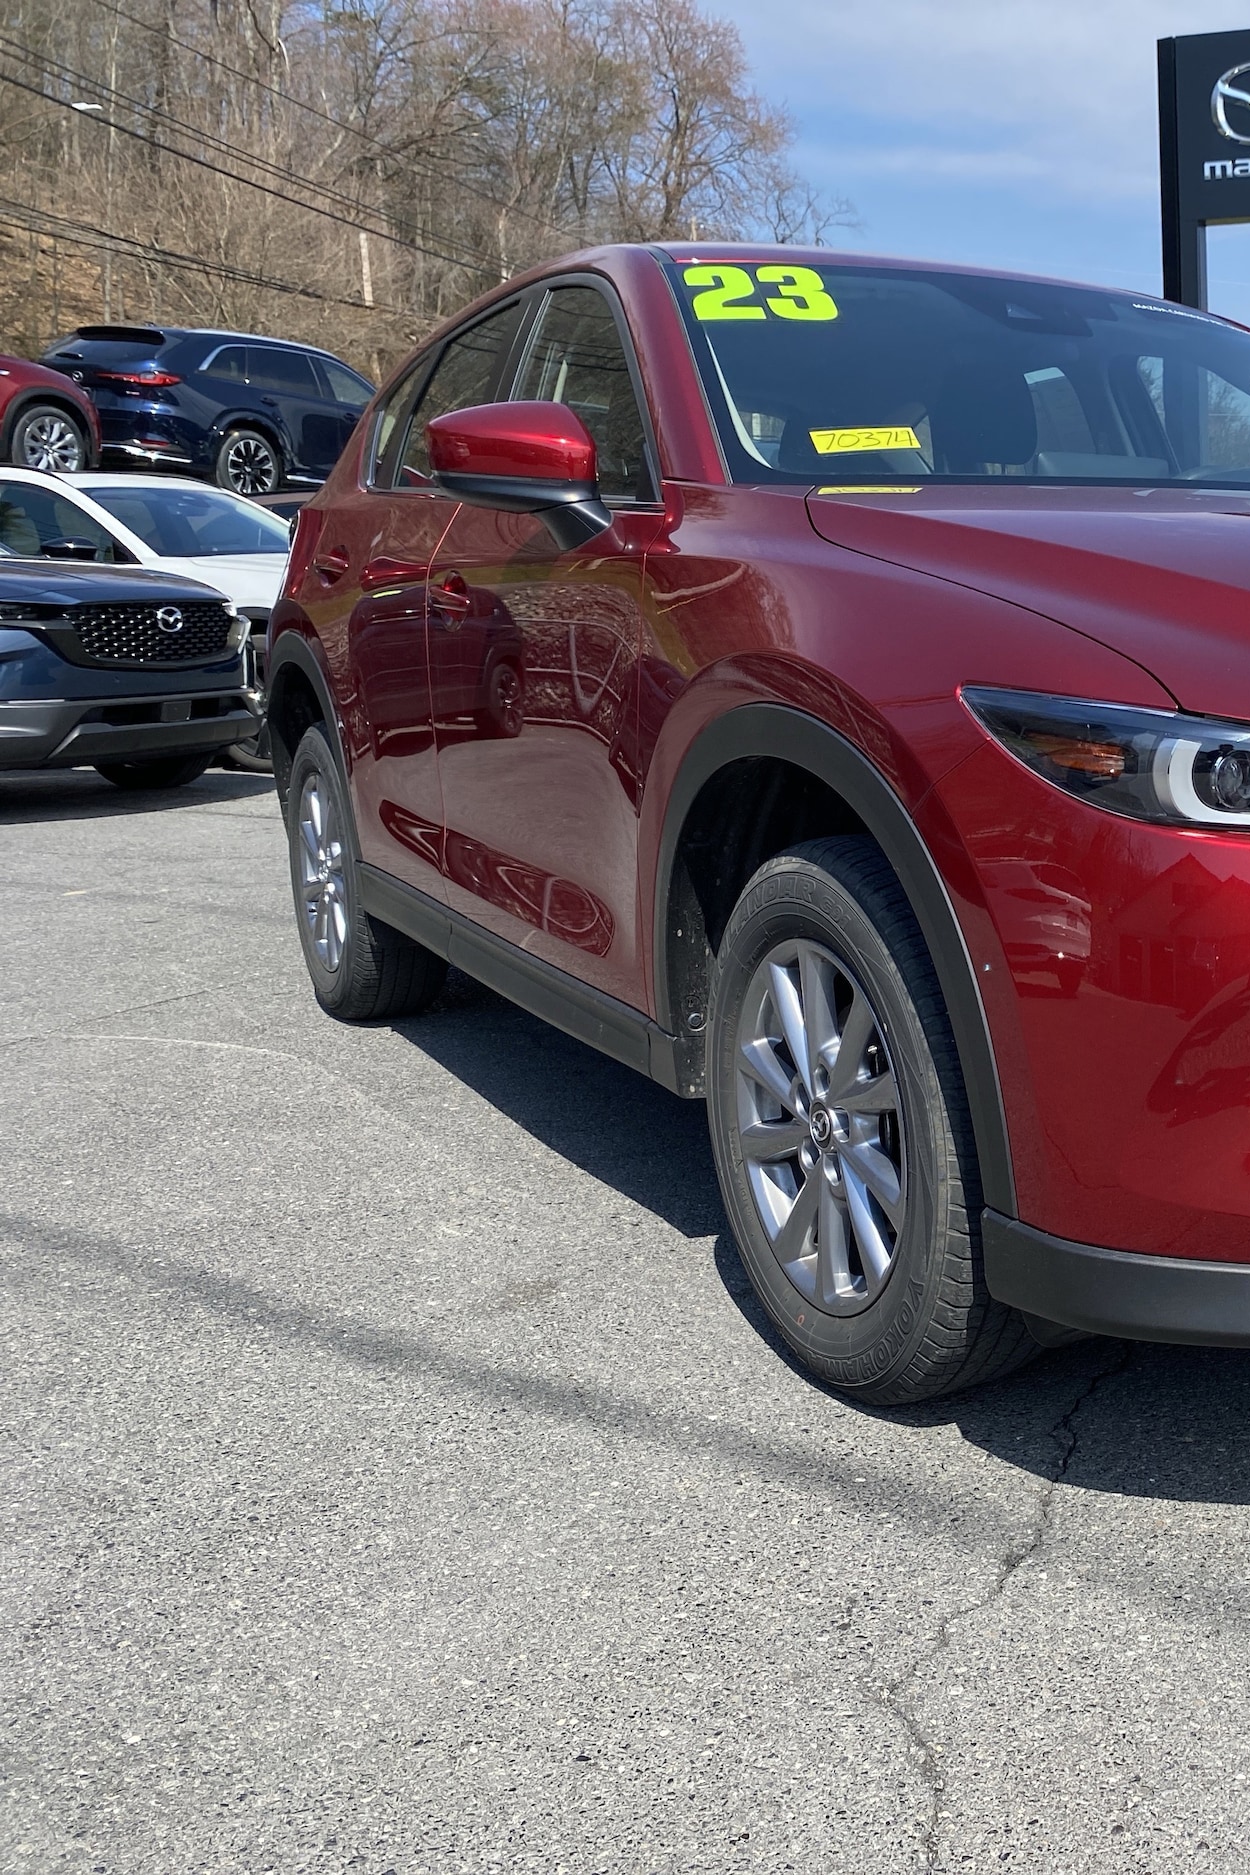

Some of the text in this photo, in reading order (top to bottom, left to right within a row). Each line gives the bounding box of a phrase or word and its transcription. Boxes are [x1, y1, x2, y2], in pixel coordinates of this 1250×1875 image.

[683, 265, 839, 321] 23
[815, 430, 916, 450] 70374
[806, 1275, 926, 1380] YOKOHAMA
